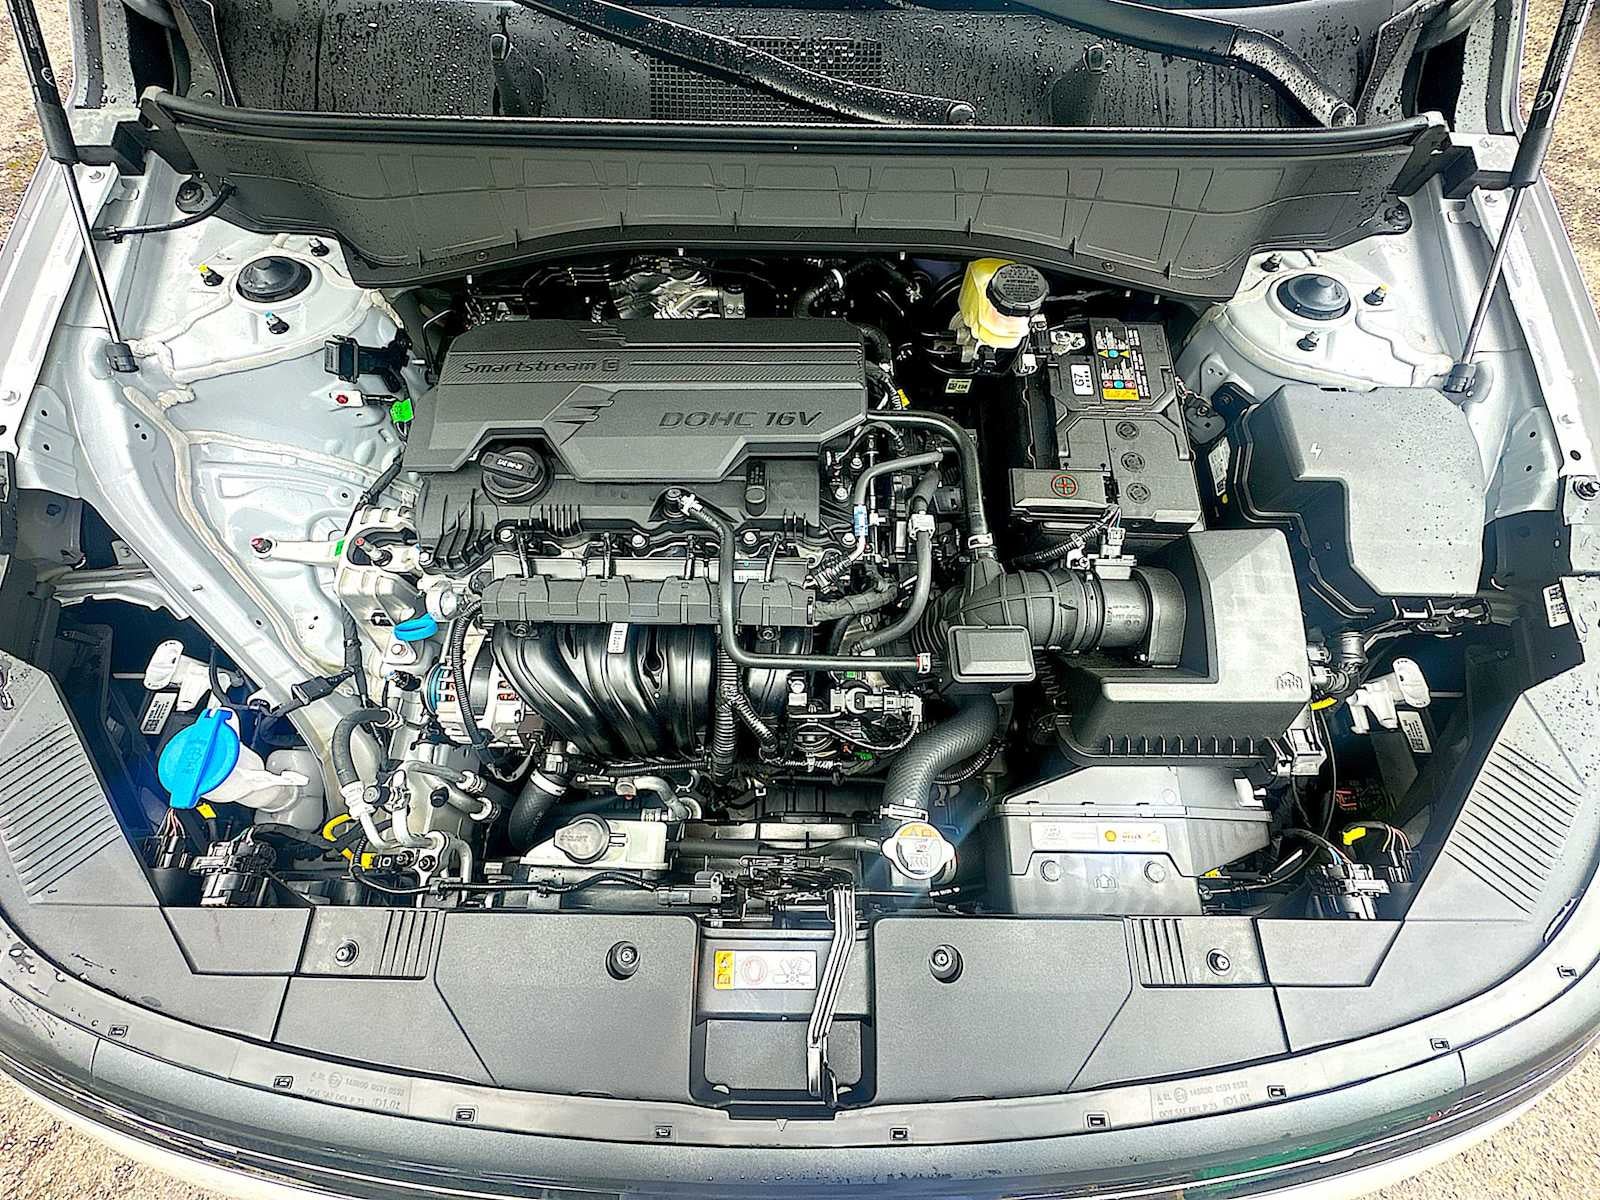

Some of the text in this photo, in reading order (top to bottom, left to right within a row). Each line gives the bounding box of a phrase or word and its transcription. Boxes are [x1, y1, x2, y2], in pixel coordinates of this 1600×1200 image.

[459, 359, 598, 374] Smartstream
[658, 410, 823, 428] DOHC 16V
